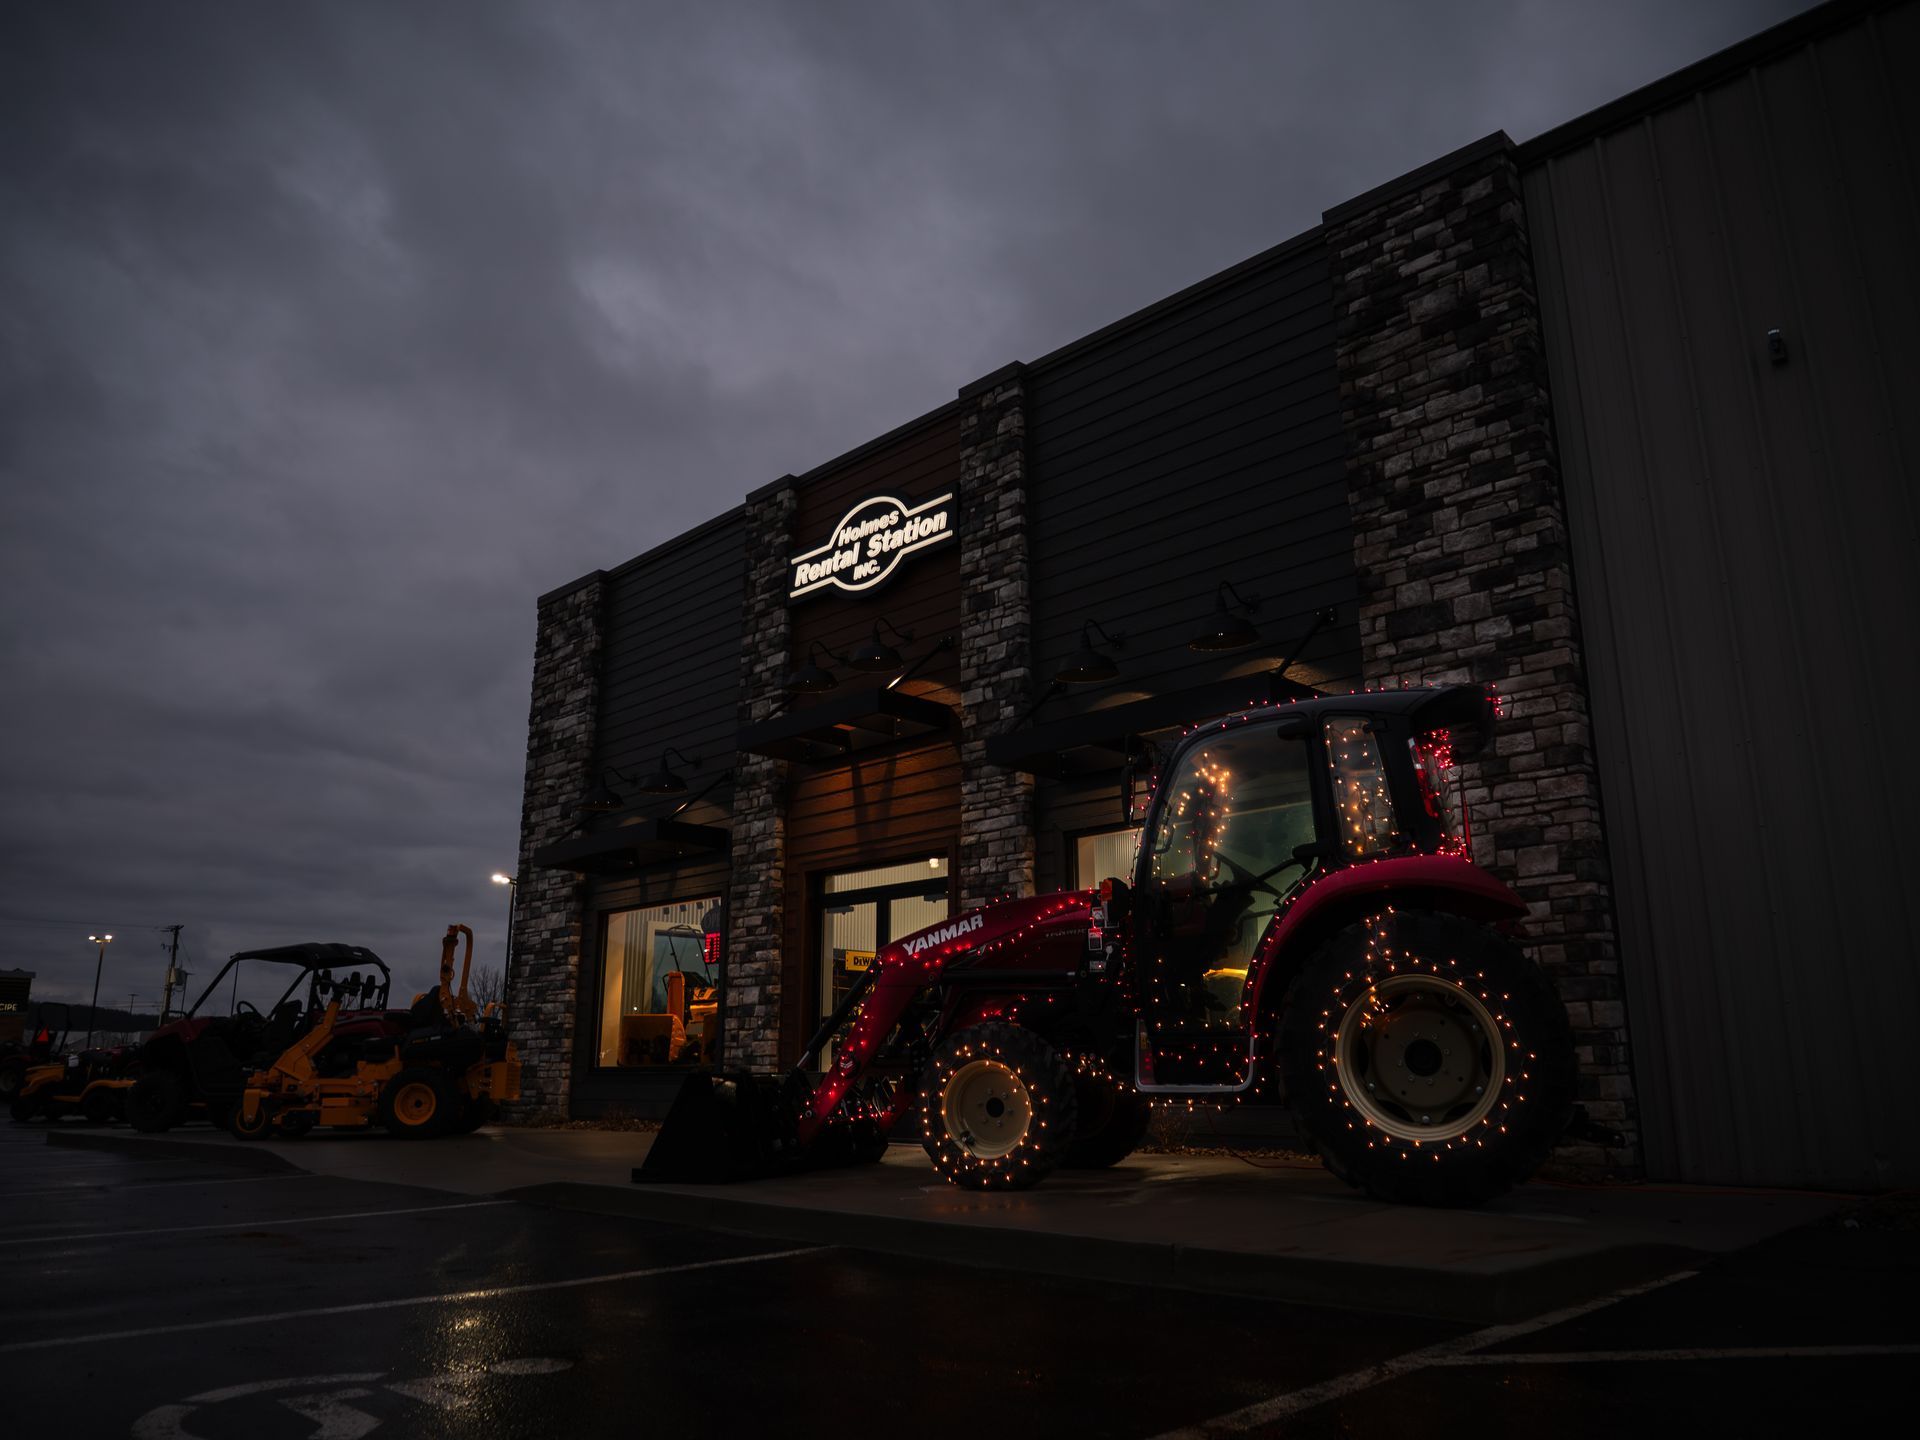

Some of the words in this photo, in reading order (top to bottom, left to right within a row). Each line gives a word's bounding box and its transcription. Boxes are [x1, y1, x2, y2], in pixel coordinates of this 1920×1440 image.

[795, 541, 861, 588] Rental
[867, 511, 948, 558] Station
[838, 510, 899, 547] Holmes
[902, 914, 983, 956] YANMAR
